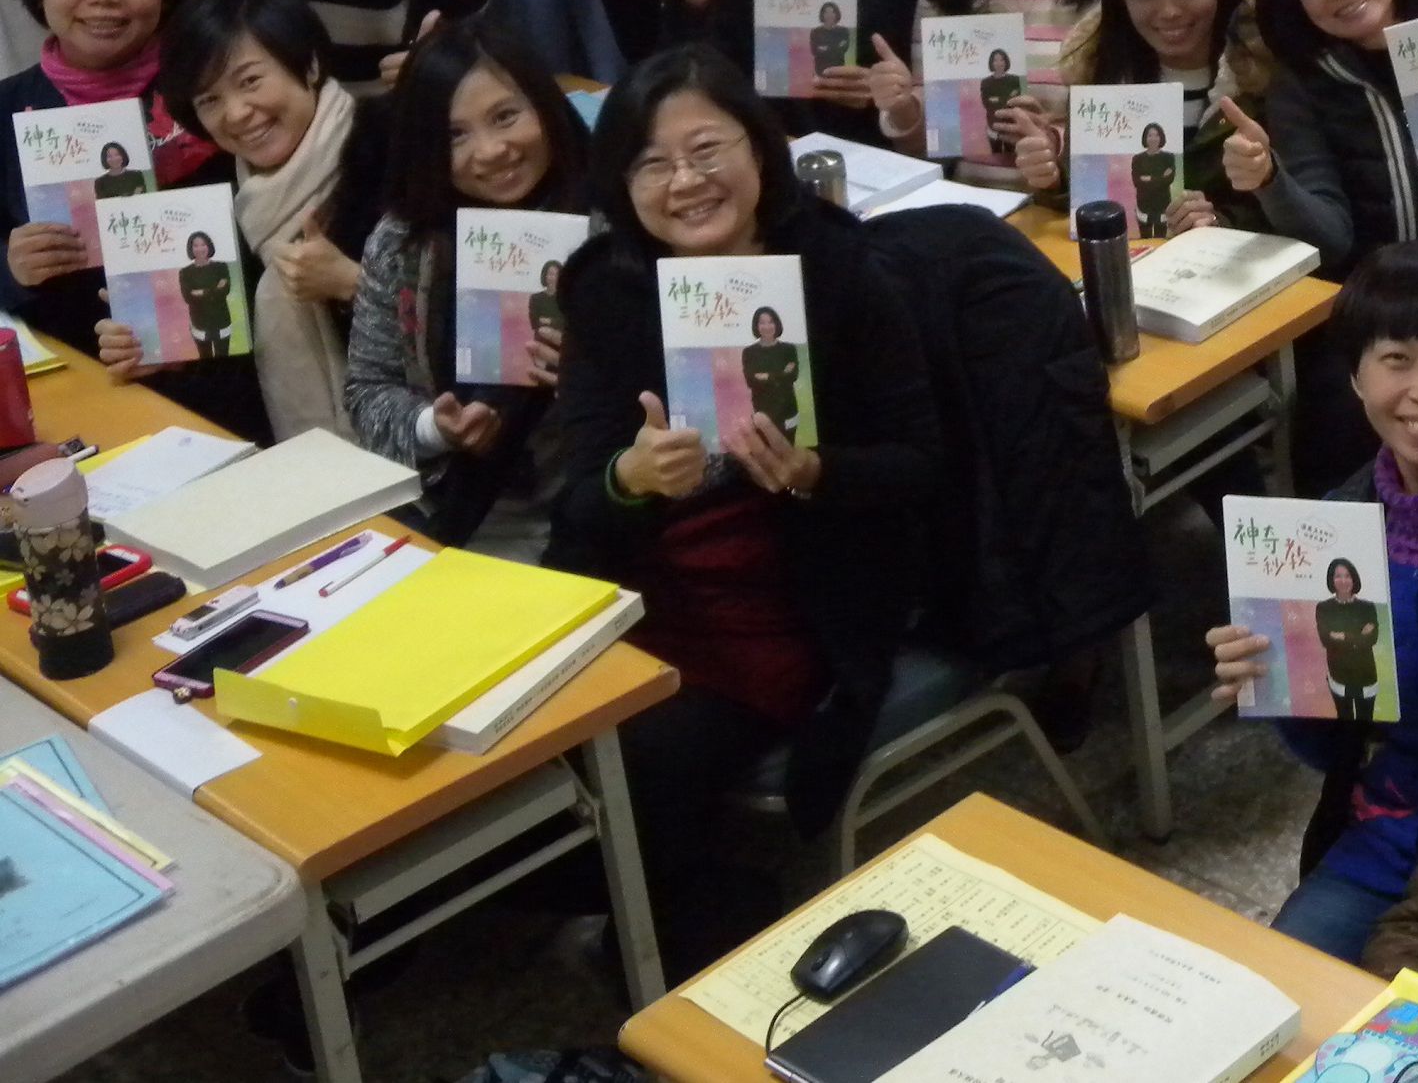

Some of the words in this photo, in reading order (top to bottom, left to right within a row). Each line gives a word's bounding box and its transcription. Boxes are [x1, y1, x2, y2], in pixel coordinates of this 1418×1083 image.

[1078, 98, 1110, 123] 神奇
[23, 124, 59, 149] 神奇
[107, 213, 145, 236] 神奇
[465, 226, 504, 256] 神奇
[668, 275, 708, 307] 神奇
[1233, 517, 1280, 554] 神奇
